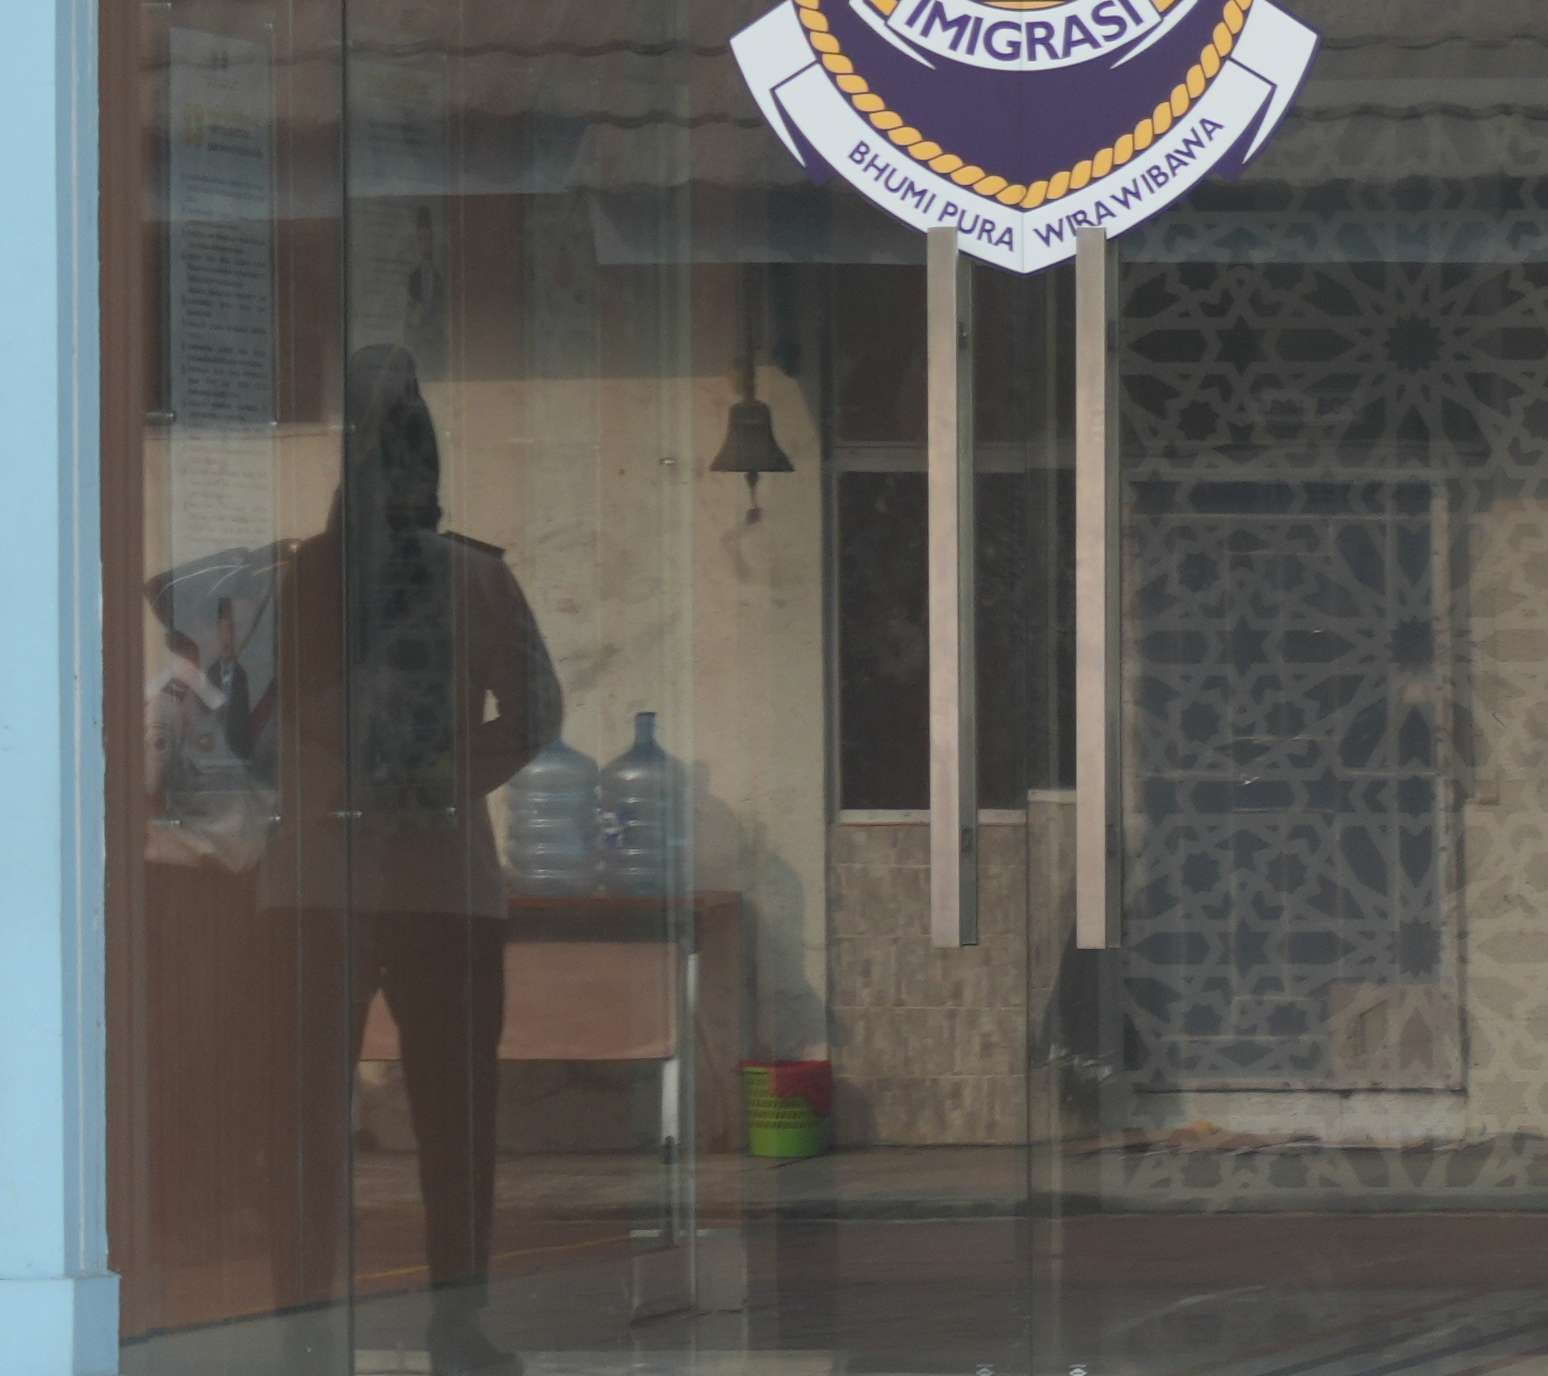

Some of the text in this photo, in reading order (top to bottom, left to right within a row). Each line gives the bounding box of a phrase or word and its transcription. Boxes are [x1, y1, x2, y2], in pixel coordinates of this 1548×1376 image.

[848, 118, 1225, 252] BHUMI PURA WIRA WIBAWA
